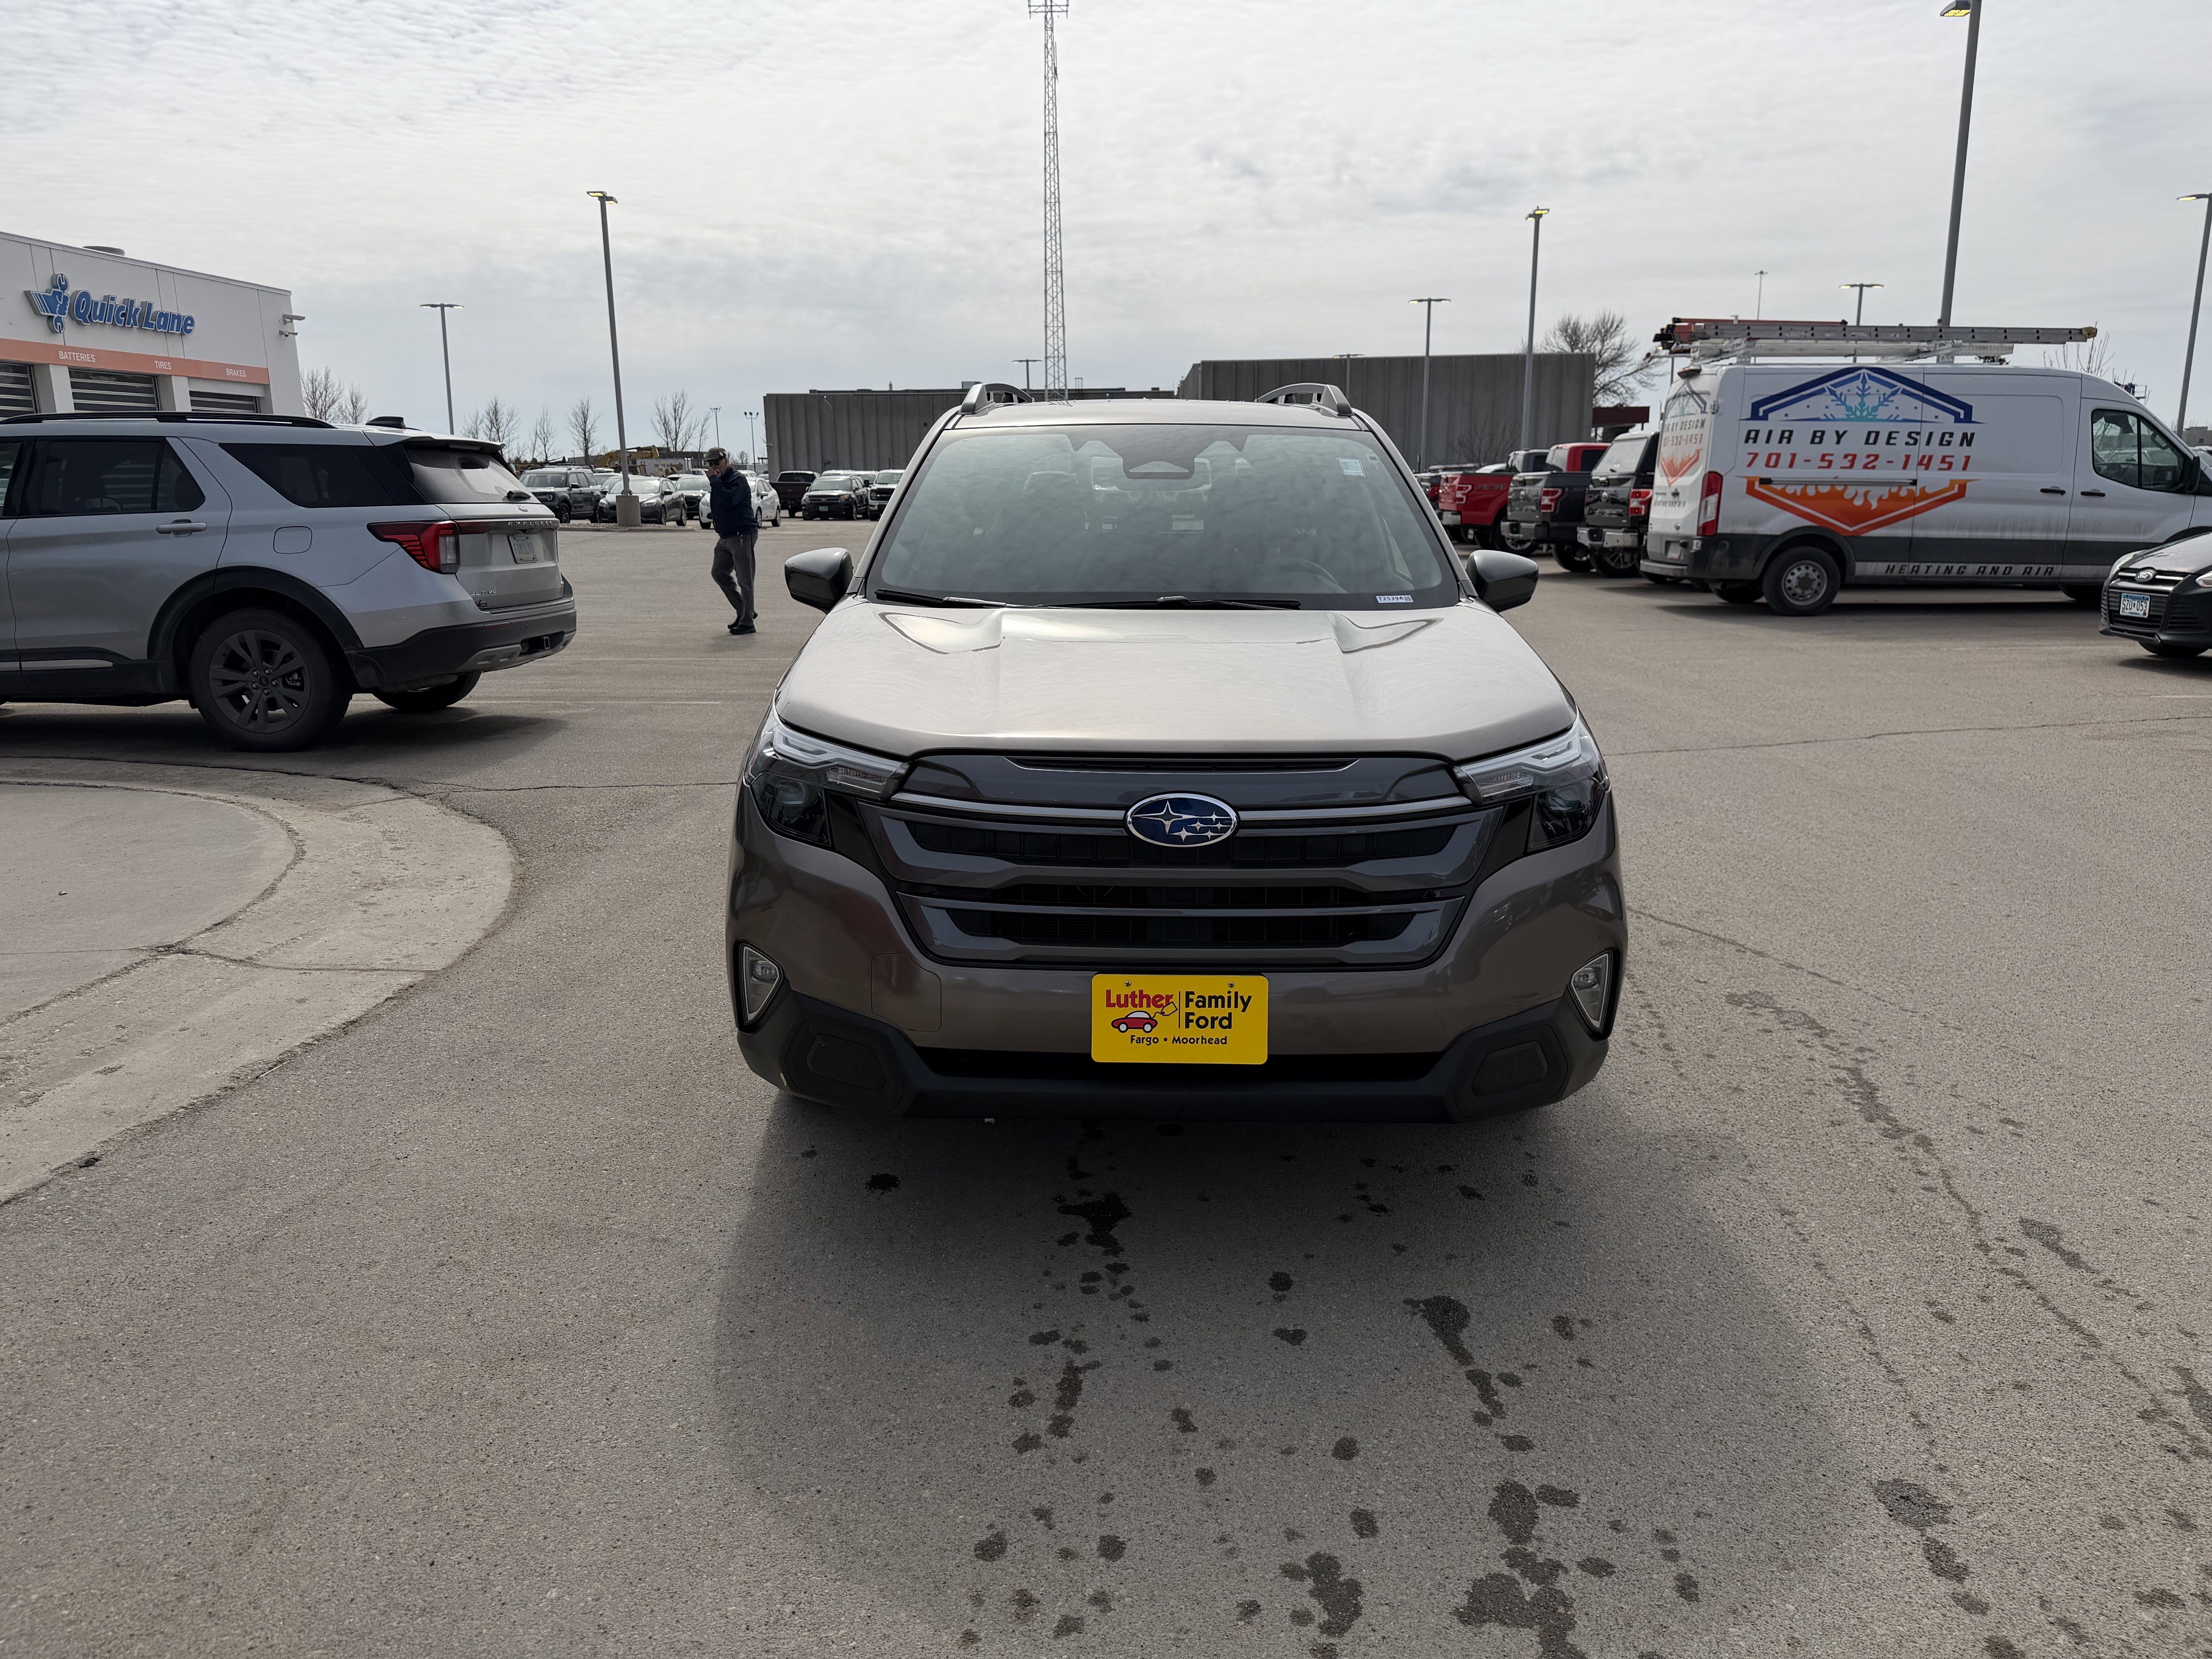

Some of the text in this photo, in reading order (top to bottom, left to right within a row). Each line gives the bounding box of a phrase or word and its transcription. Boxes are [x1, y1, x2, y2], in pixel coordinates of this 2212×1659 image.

[71, 289, 196, 335] Quick Lane
[58, 350, 96, 363] BATTERIES
[154, 360, 172, 370] TIRES
[226, 368, 246, 377] BRAKES
[1744, 429, 1975, 447] AIR BY DESIGN
[1746, 452, 1972, 471] 701-532-1451
[1885, 564, 2054, 576] HEATING AND AIR
[1106, 989, 1173, 1008] Luther
[1185, 990, 1252, 1012] Family
[1185, 1012, 1232, 1029] Ford
[1130, 1035, 1228, 1045] Fargo Moorhead
